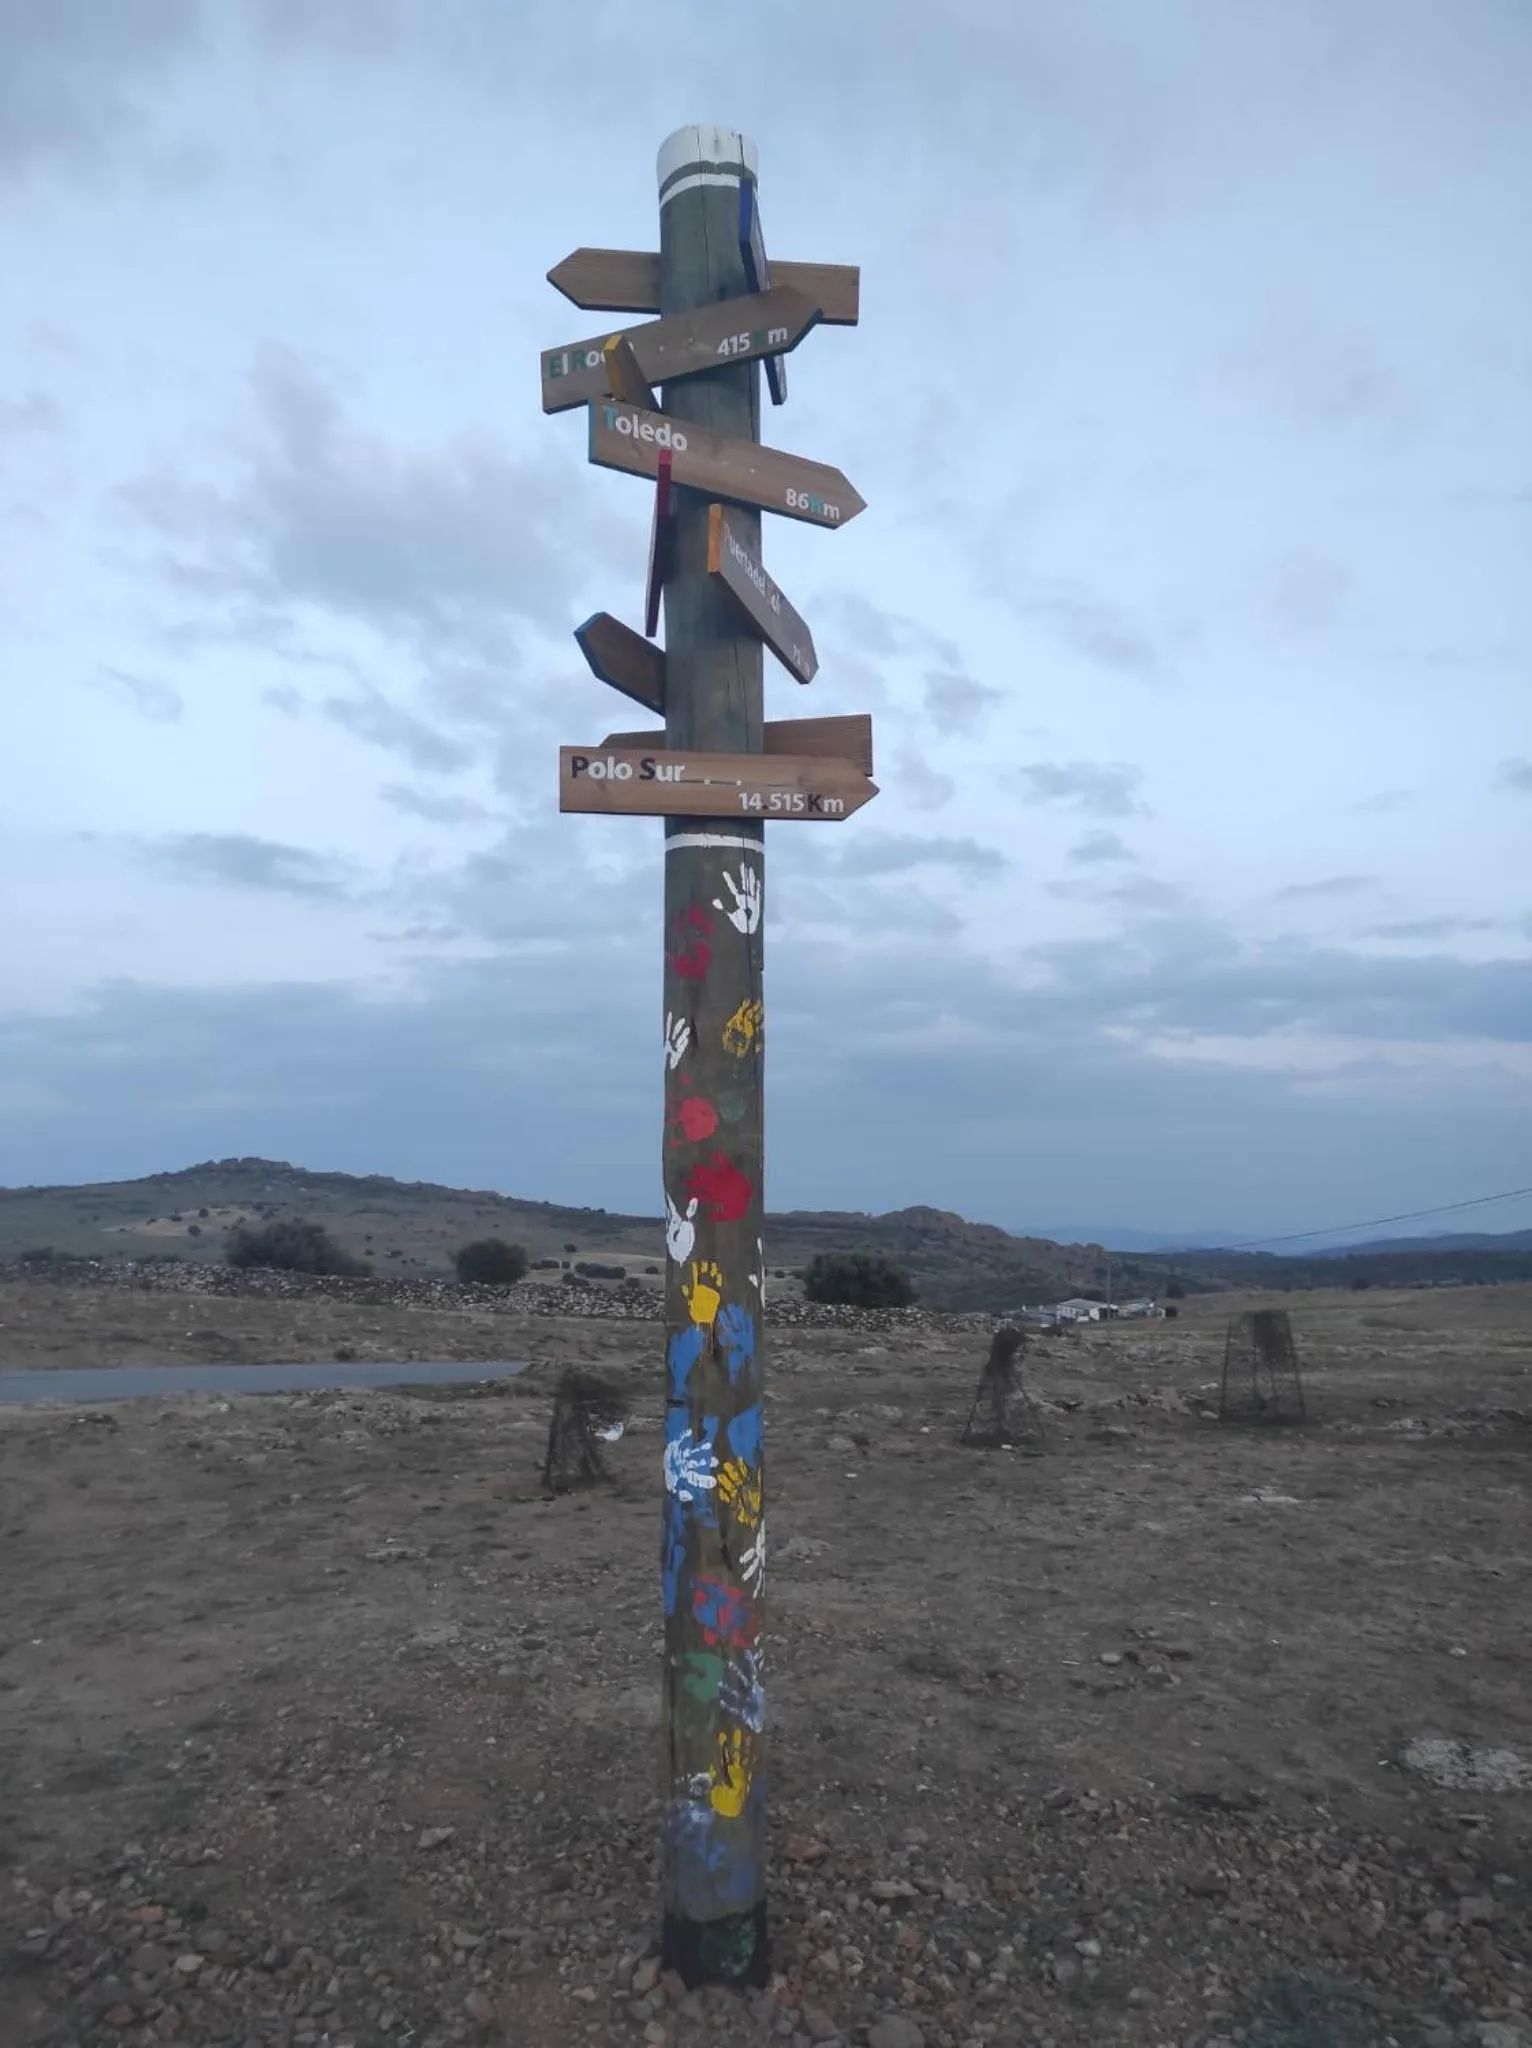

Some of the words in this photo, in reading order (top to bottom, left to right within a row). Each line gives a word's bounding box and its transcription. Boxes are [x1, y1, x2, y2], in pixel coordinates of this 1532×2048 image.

[548, 352, 569, 379] El
[602, 404, 688, 452] Toledo
[571, 755, 633, 780] Polo
[640, 757, 685, 782] Sur
